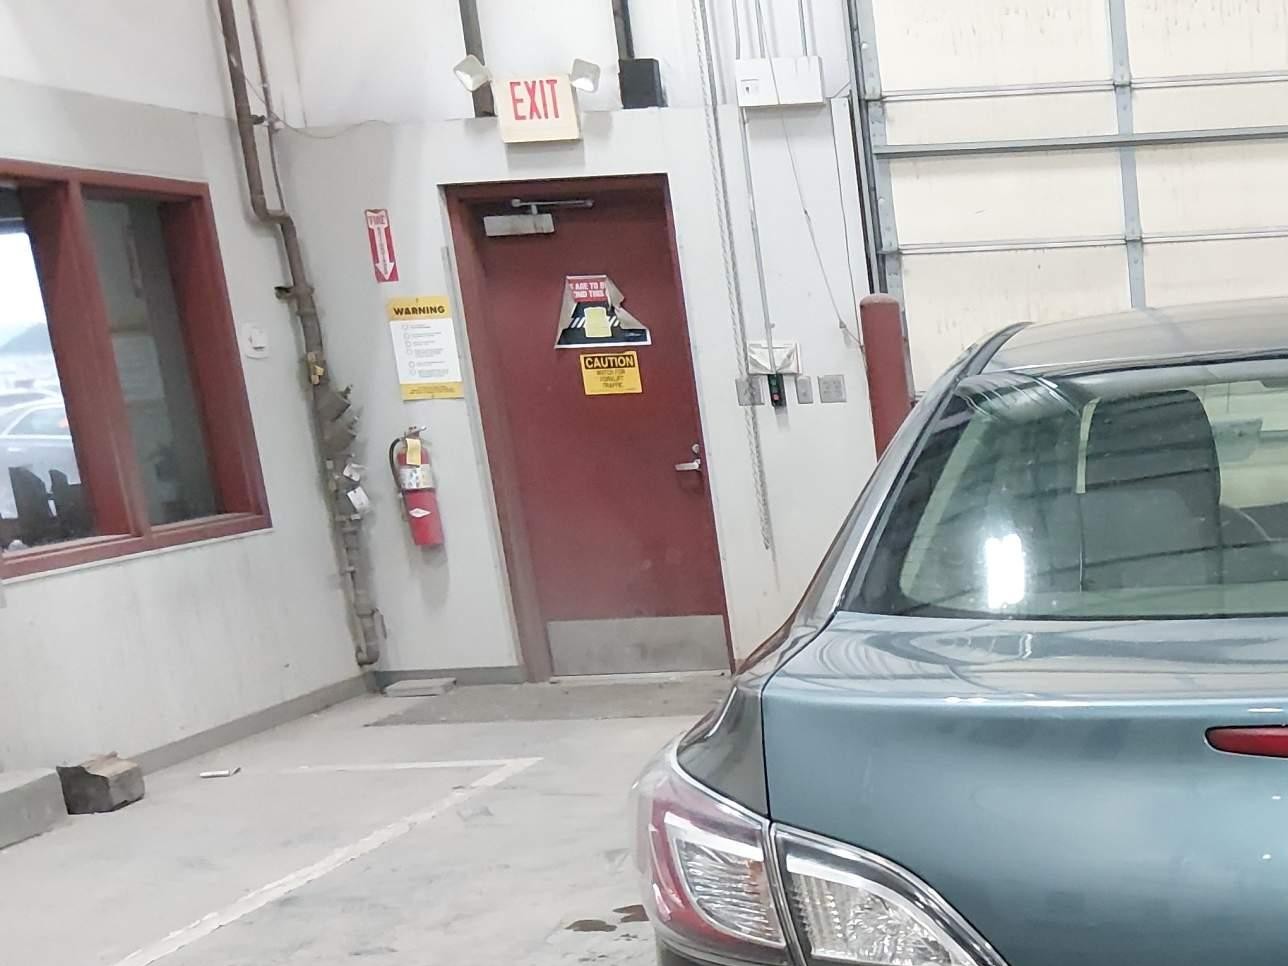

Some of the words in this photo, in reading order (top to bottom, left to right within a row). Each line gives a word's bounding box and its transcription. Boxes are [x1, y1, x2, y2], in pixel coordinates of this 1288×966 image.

[509, 79, 560, 120] EXIT
[393, 306, 445, 316] WARNING
[585, 356, 634, 368] CAUTION
